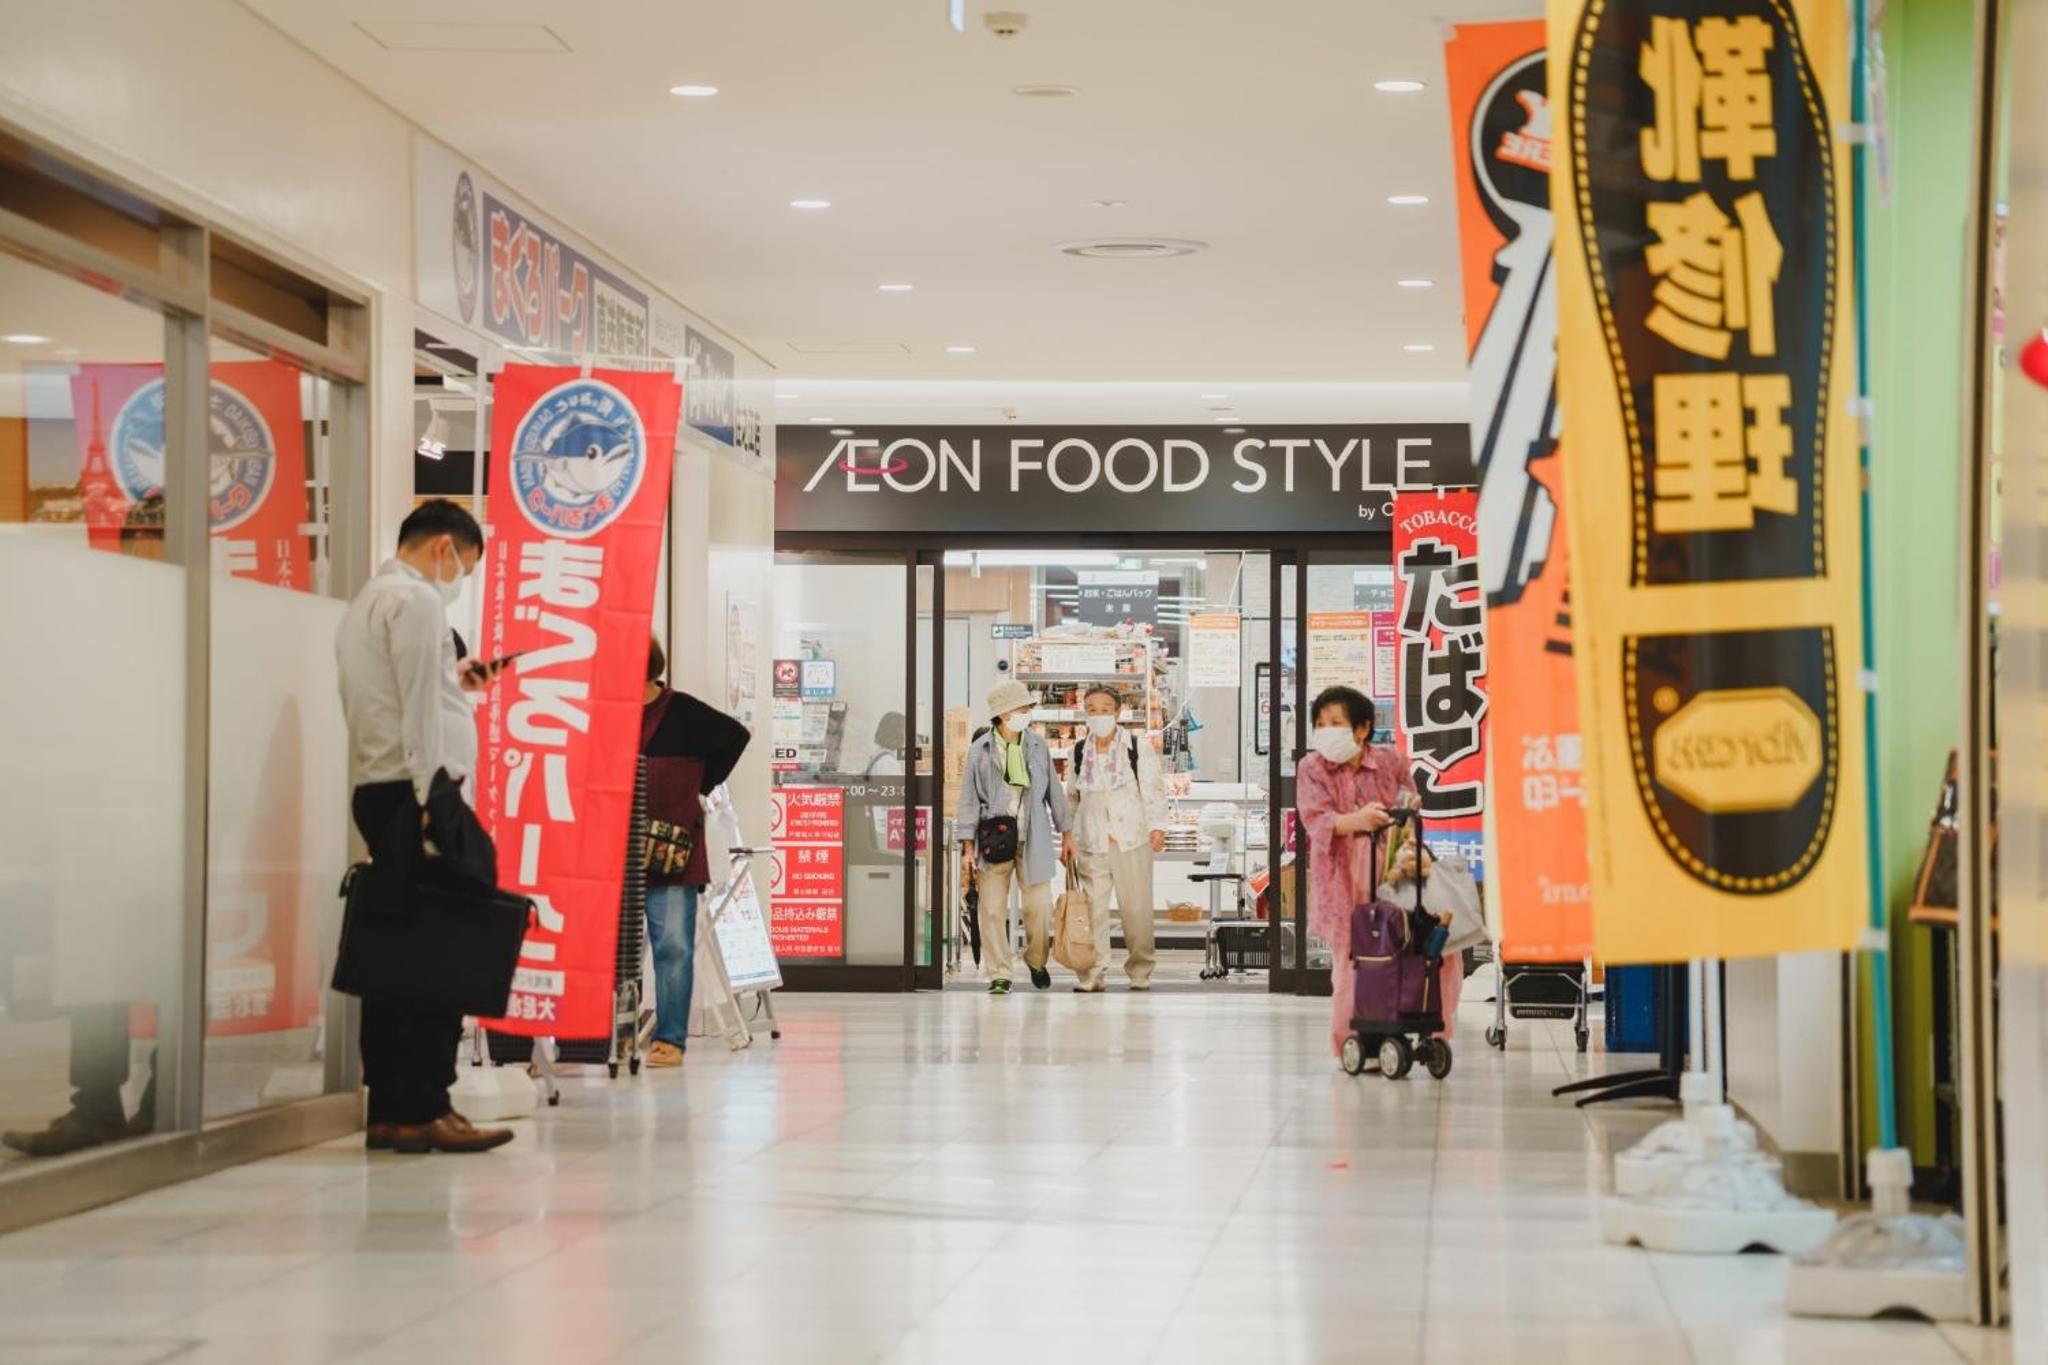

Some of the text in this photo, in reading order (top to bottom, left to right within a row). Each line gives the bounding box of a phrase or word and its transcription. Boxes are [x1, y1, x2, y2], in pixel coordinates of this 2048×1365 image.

[490, 209, 589, 359] まぐろパーク
[1010, 438, 1210, 493] FOOD
[1231, 437, 1433, 493] STYLE
[1358, 504, 1376, 521] by
[1398, 538, 1487, 818] たばこ
[771, 748, 797, 759] ED
[788, 792, 840, 807] 火気厳禁
[889, 829, 926, 842] AM
[1423, 840, 1484, 869] 売中
